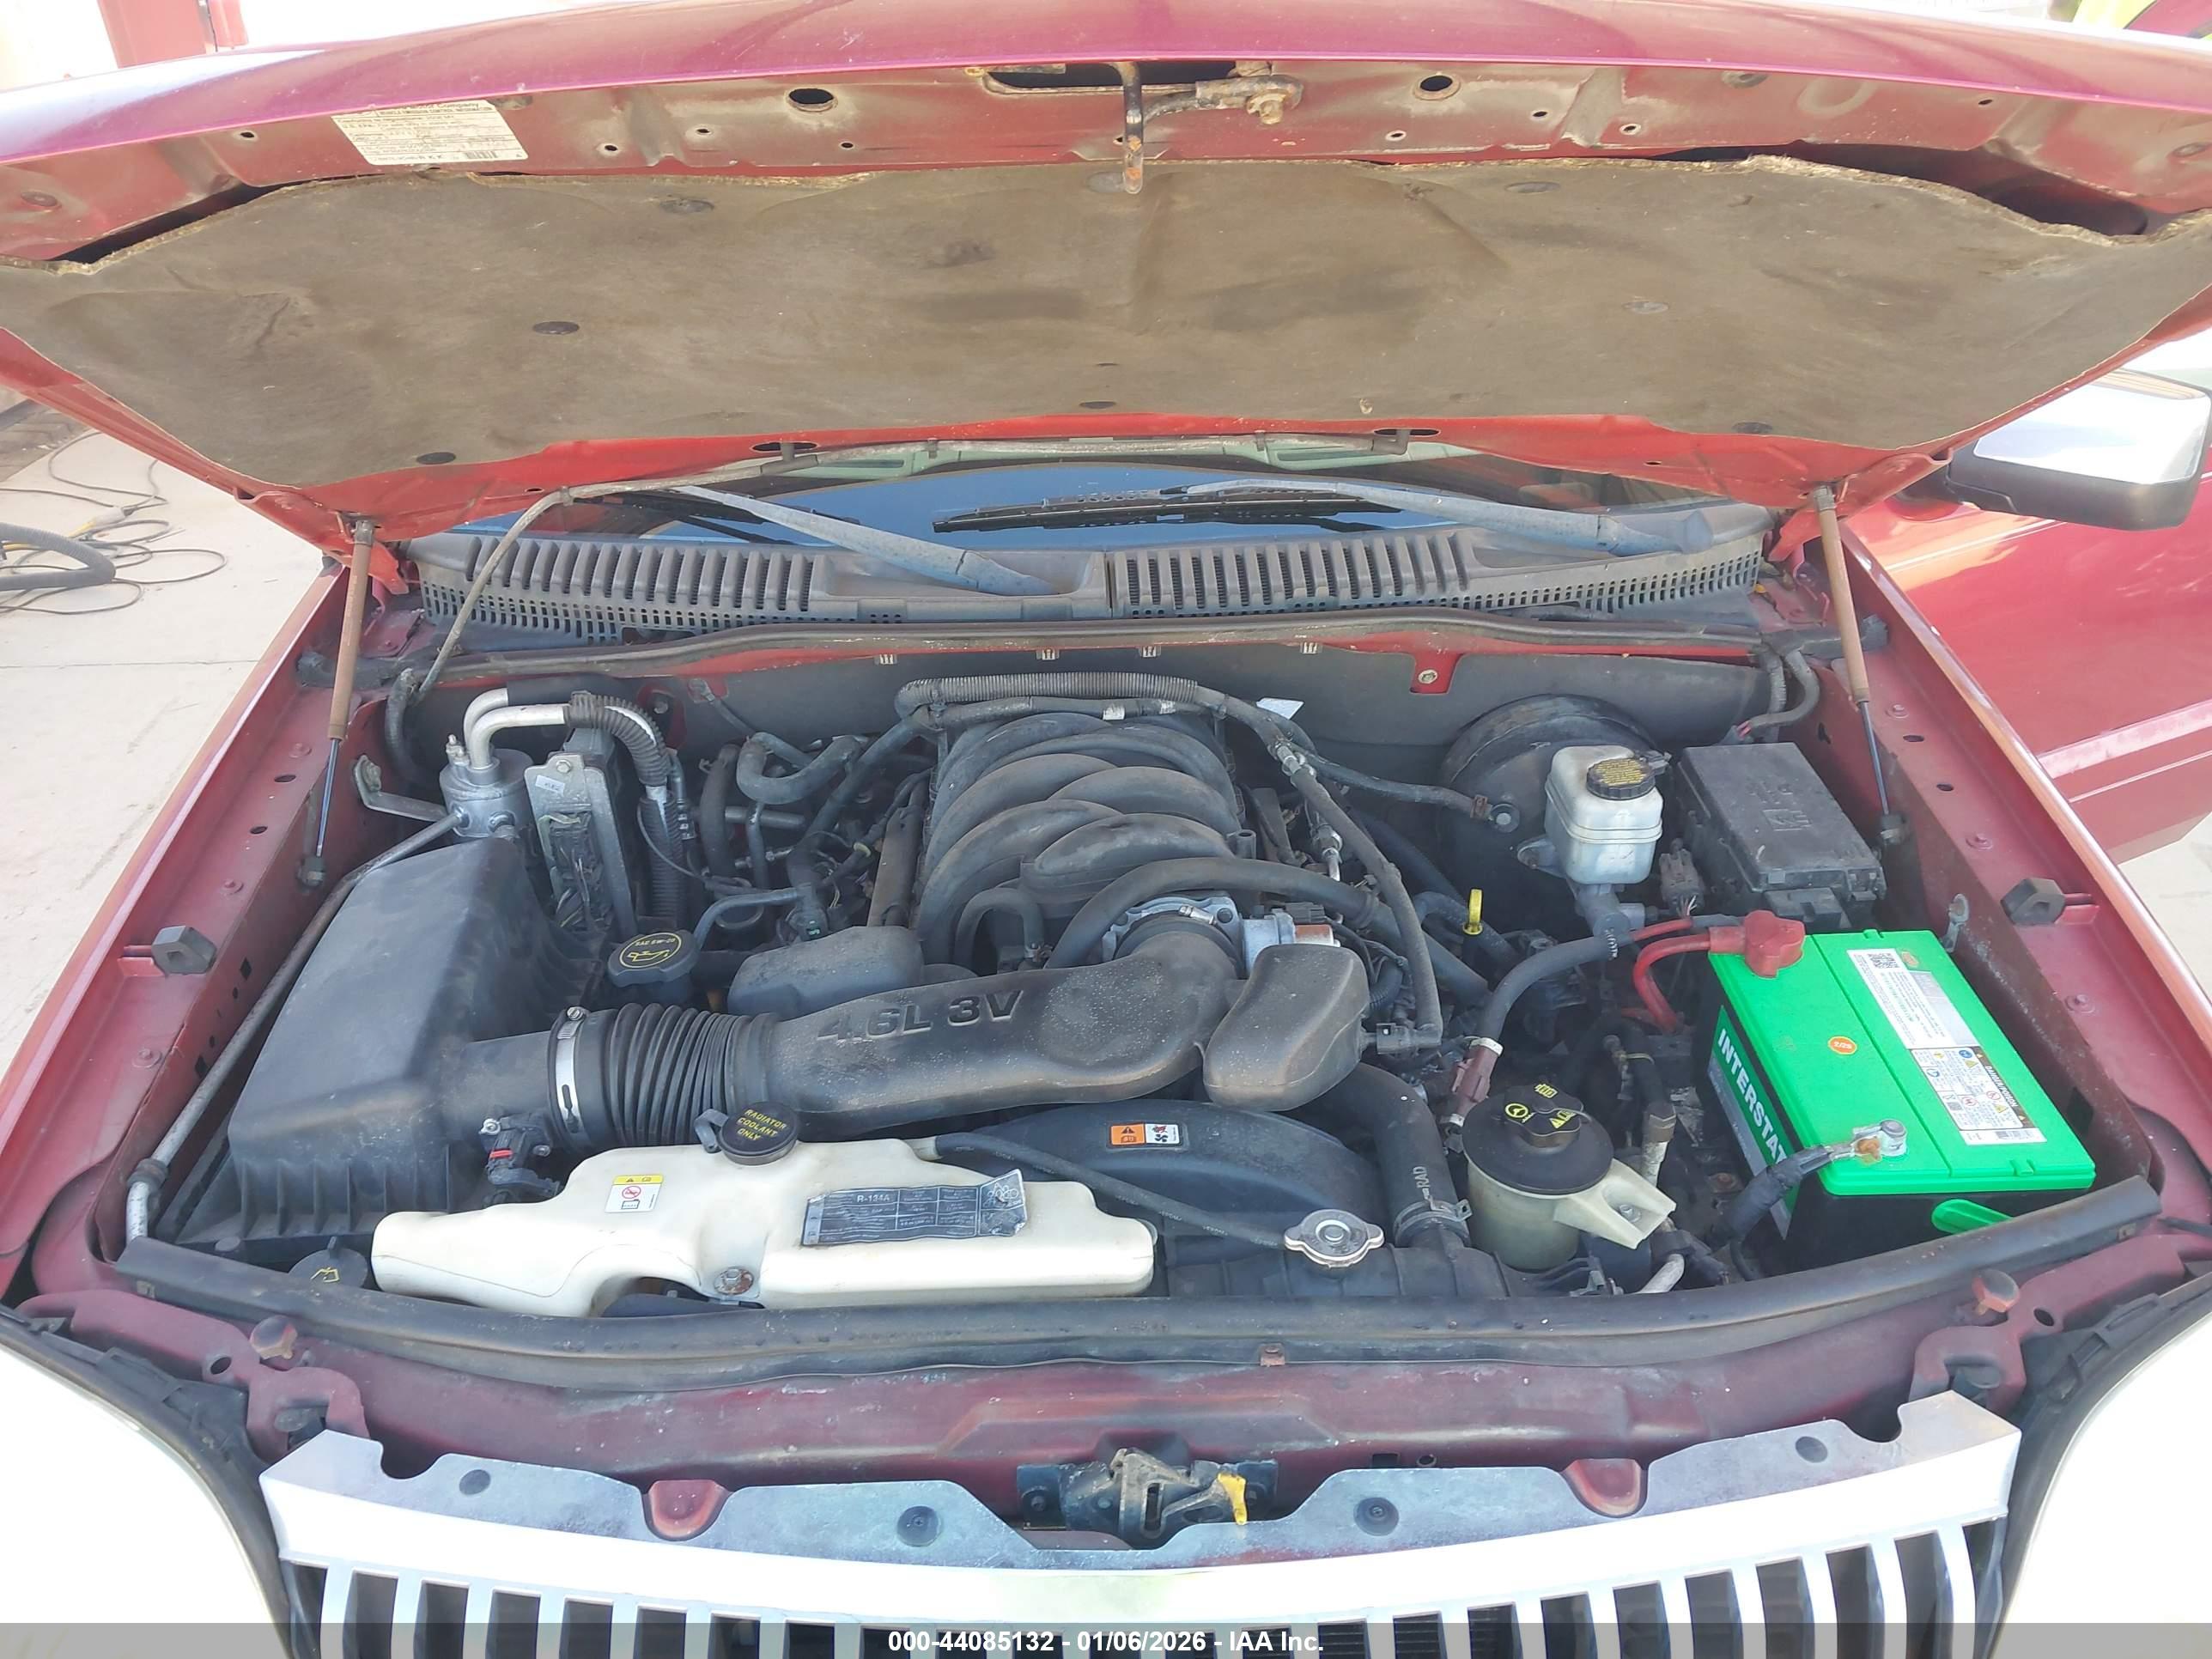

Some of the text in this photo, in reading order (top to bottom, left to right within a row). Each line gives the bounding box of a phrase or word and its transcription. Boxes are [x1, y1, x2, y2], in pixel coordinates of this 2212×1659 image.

[817, 990, 1024, 1042] 4.6L 3V
[737, 1117, 779, 1137] COOLANT
[744, 1109, 787, 1129] RADIATOR
[737, 1127, 762, 1140] ONLY
[1413, 1165, 1431, 1188] RAD
